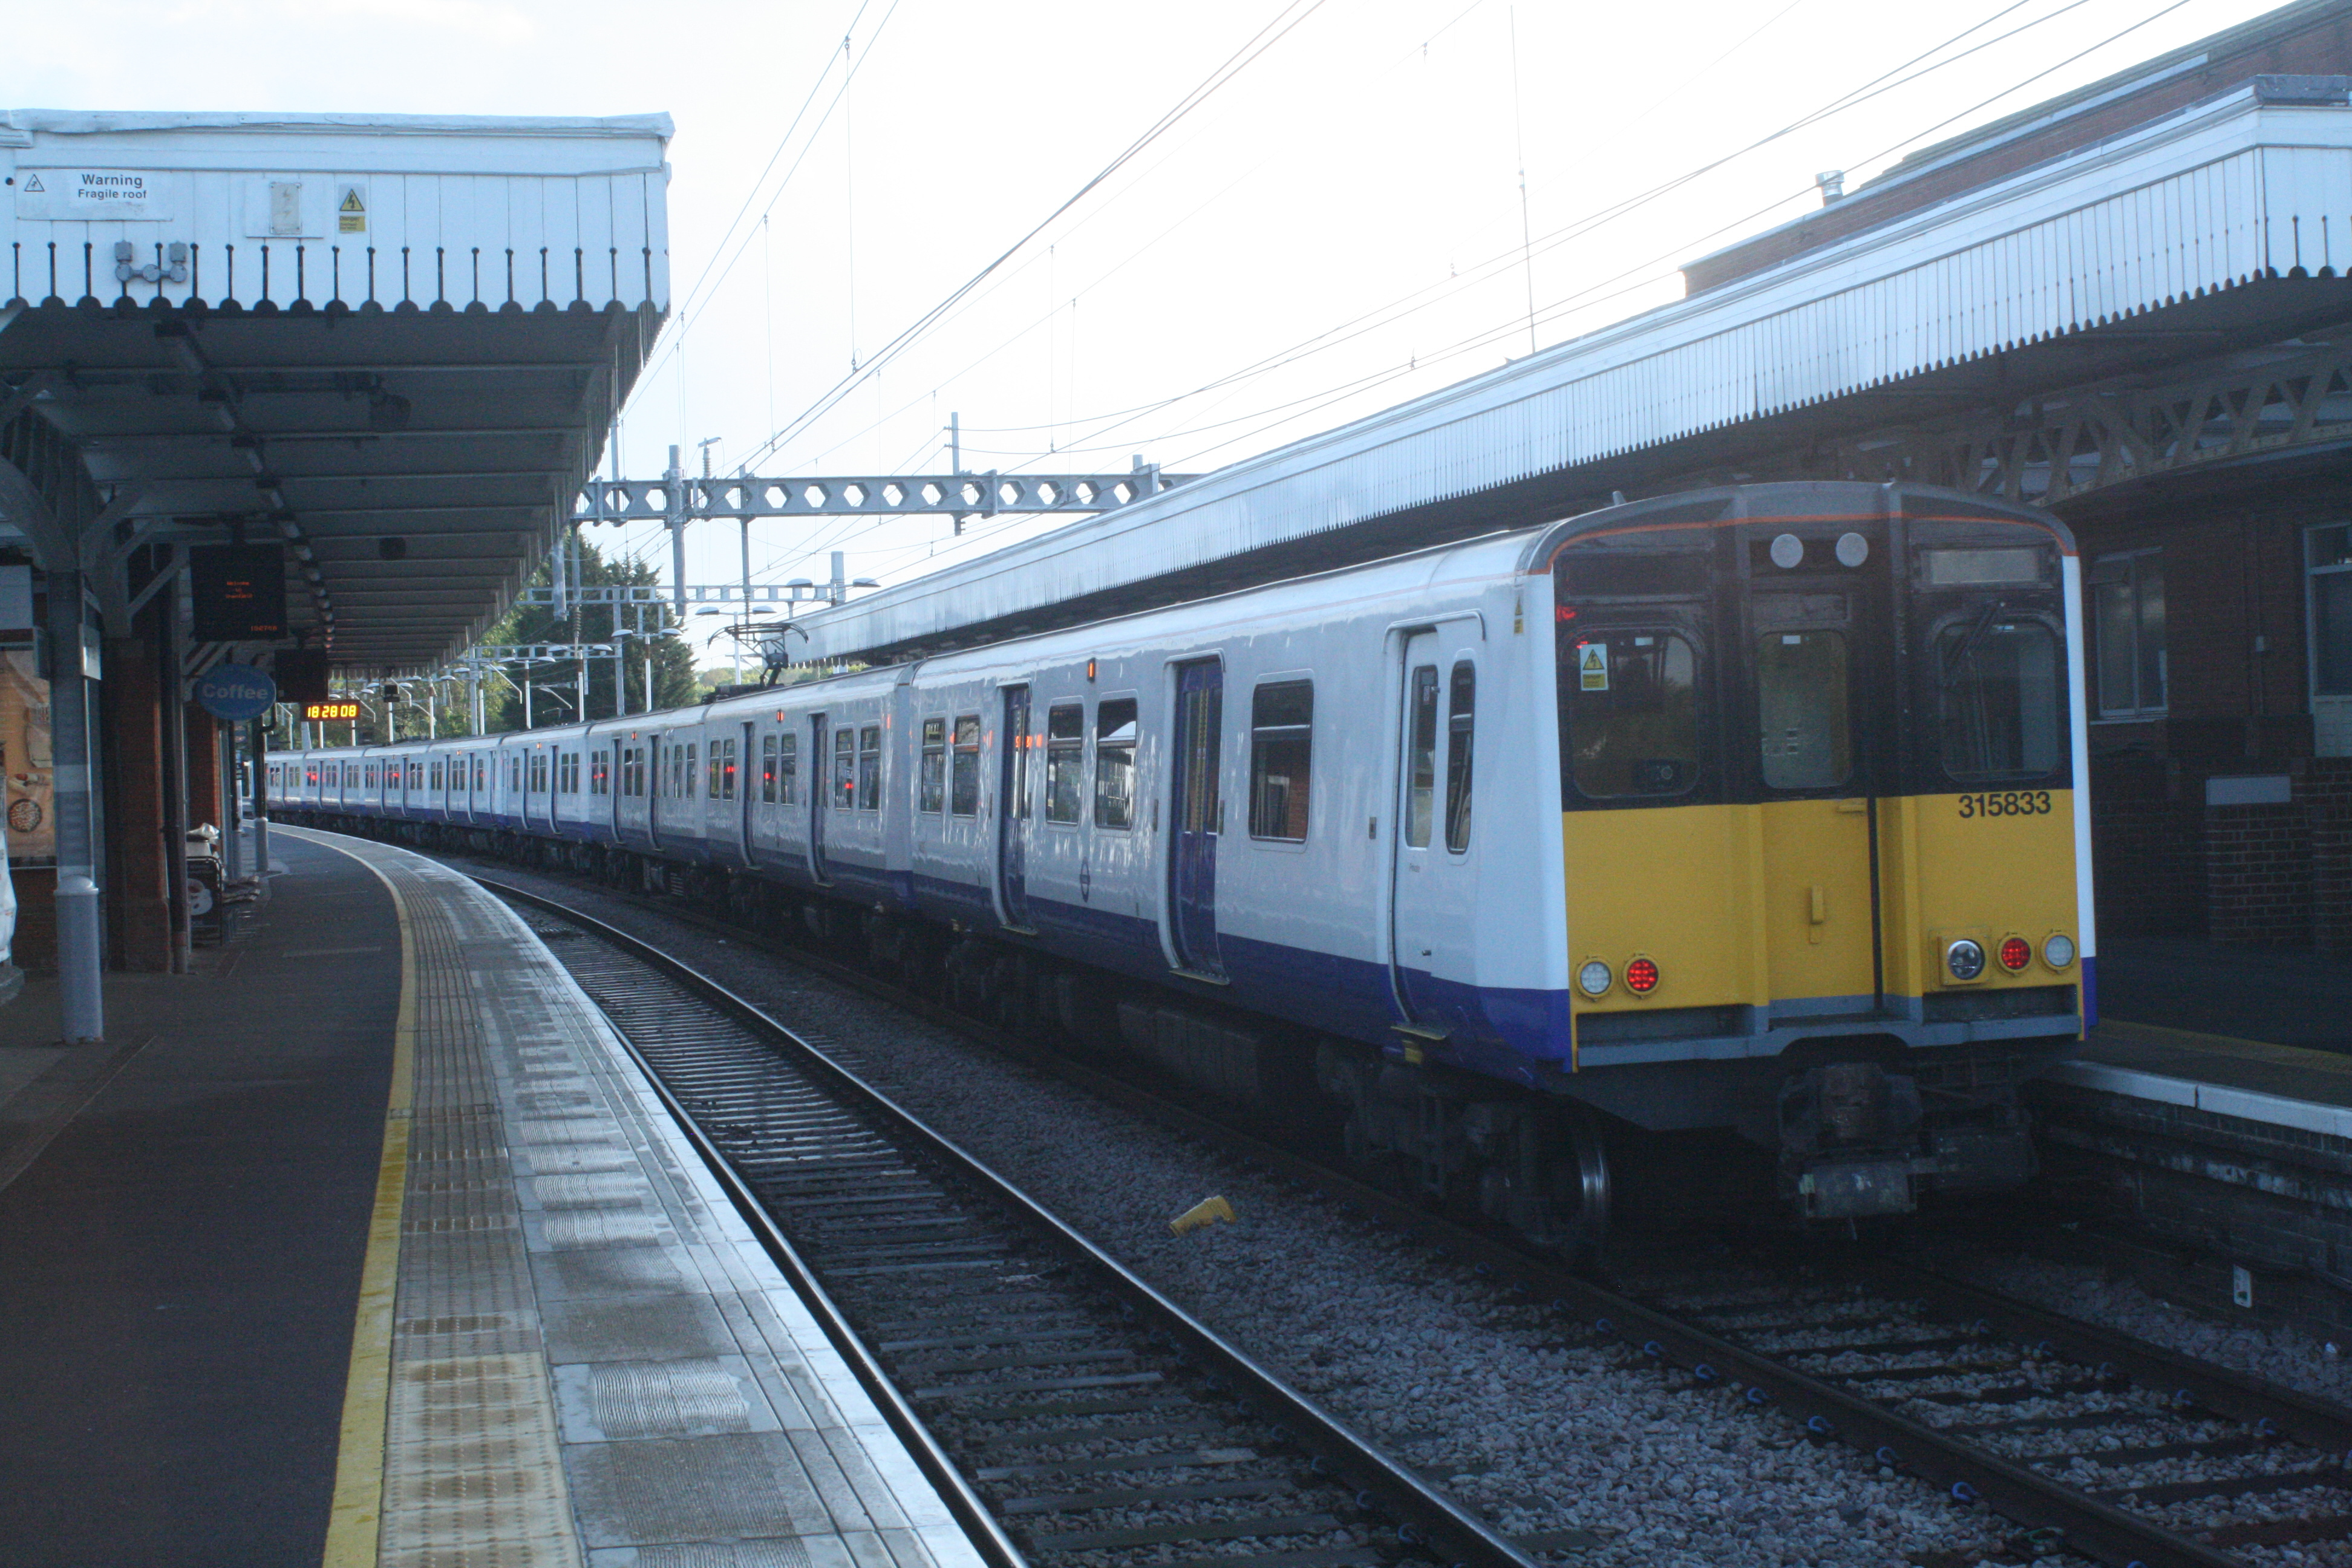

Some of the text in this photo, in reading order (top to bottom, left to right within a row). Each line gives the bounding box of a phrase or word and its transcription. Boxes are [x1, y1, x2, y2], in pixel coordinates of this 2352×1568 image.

[82, 174, 143, 189] Warning
[78, 189, 147, 200] Fragile roof
[203, 684, 268, 699] Coffee
[1958, 791, 2051, 818] 315833
